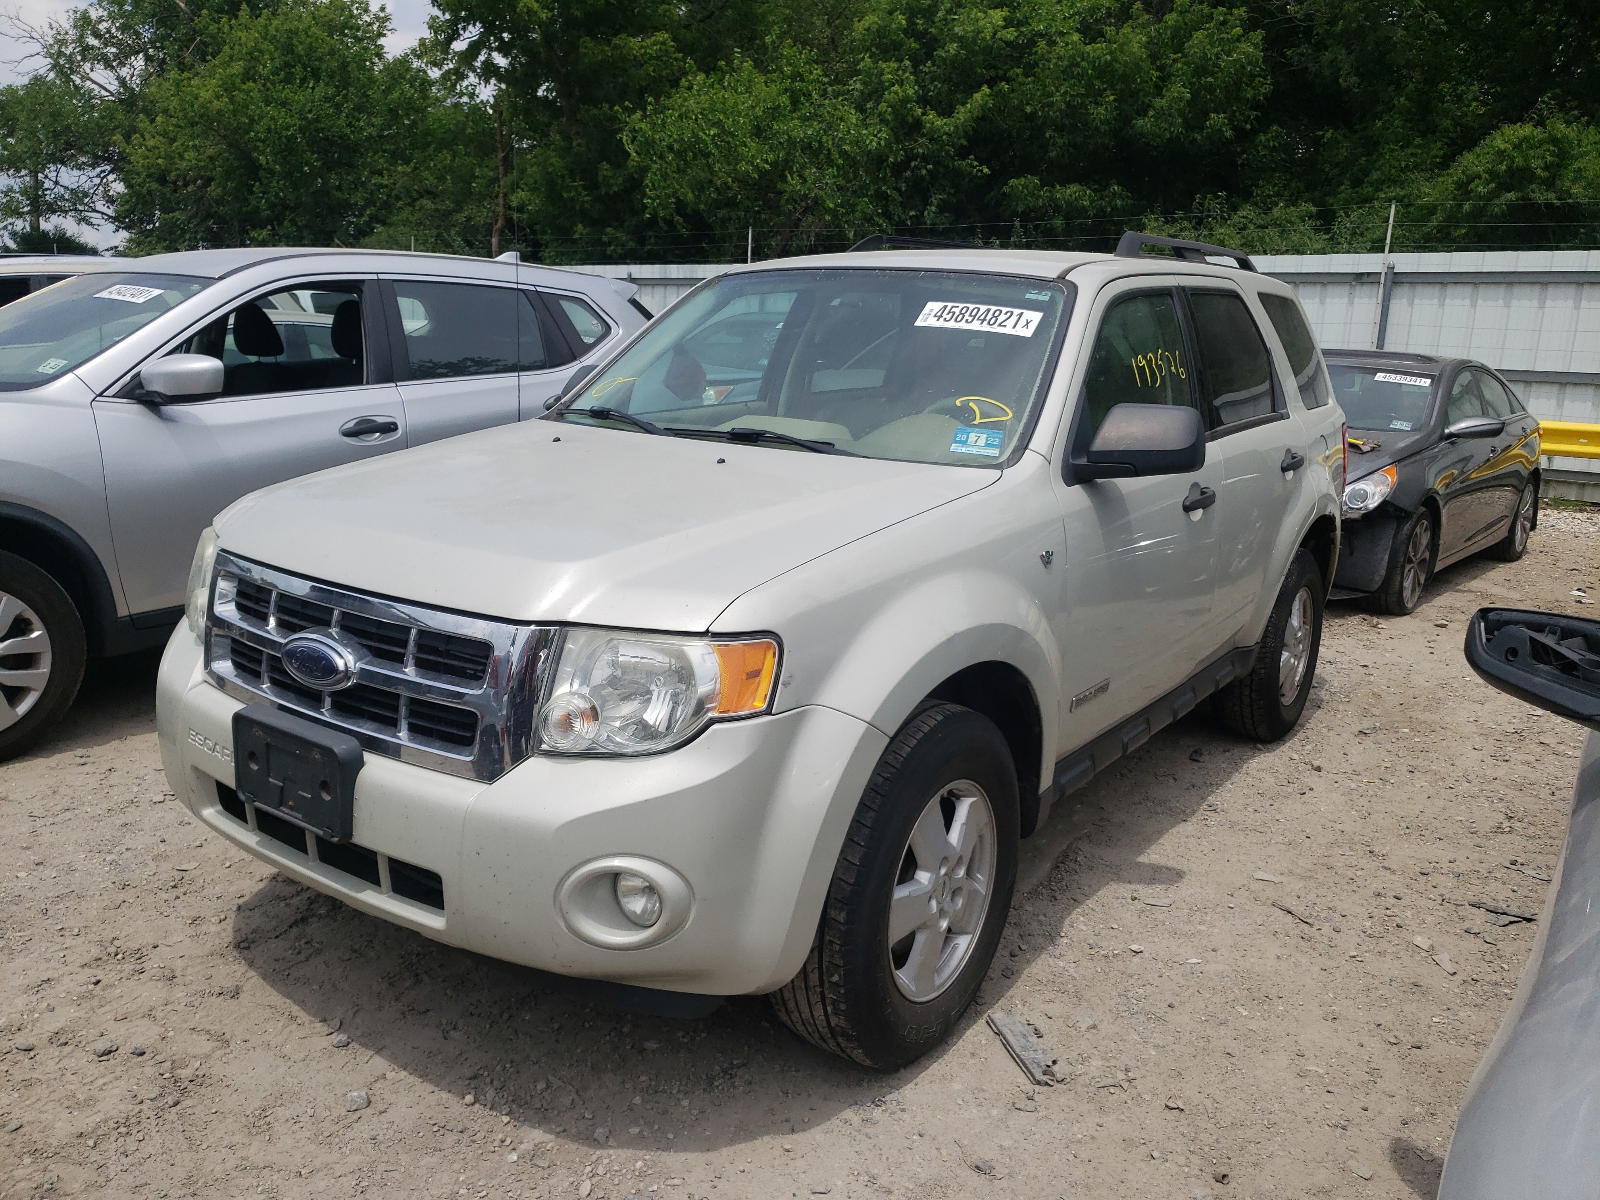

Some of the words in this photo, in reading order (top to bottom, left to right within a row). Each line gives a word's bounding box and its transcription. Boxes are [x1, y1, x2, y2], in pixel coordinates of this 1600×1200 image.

[955, 433, 967, 441] 20
[973, 434, 981, 445] 7
[986, 436, 1000, 445] 22
